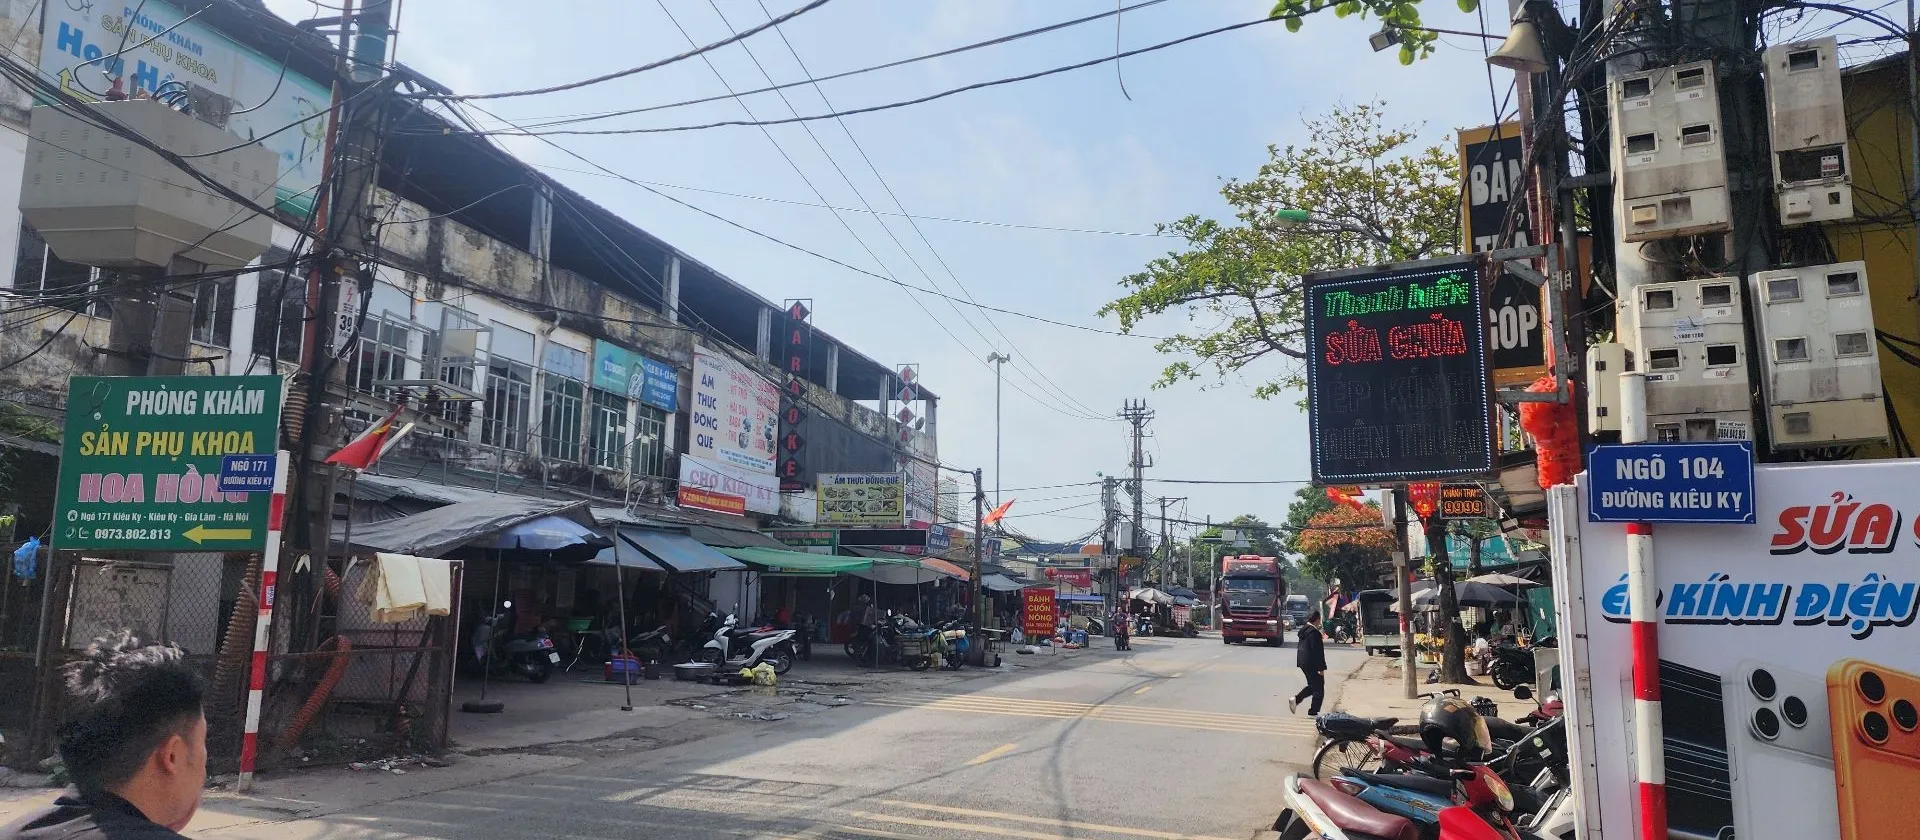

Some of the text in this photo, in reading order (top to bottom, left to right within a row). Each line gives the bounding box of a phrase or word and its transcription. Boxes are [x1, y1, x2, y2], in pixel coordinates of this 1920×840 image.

[176, 51, 217, 83] KHOA
[1325, 312, 1467, 365] SỬA CHỮA
[126, 385, 265, 415] PHÒNG KHÁM
[787, 304, 802, 477] KARAOKE
[79, 424, 254, 461] SẢN PHỤ KHOA
[231, 457, 267, 471] NGÕ 171
[1616, 453, 1725, 480] NGÕ 104
[78, 473, 145, 503] HOA
[1443, 486, 1463, 498] KHÁNH
[1601, 488, 1743, 513] ĐƯỜNG KIÊU KỴ
[98, 512, 111, 521] 171
[185, 512, 198, 521] Gia
[200, 511, 216, 521] Lâm
[223, 511, 233, 521] Hà
[1444, 500, 1483, 514] 9999
[94, 528, 171, 540] 0973.802.813
[1770, 491, 1898, 553] SỬA
[1027, 602, 1051, 612] CUỐN
[1028, 593, 1050, 603] BÁNH
[1665, 573, 1790, 624] KÍNH
[1795, 572, 1918, 638] ĐIỆN
[1028, 612, 1053, 621] NÓNG
